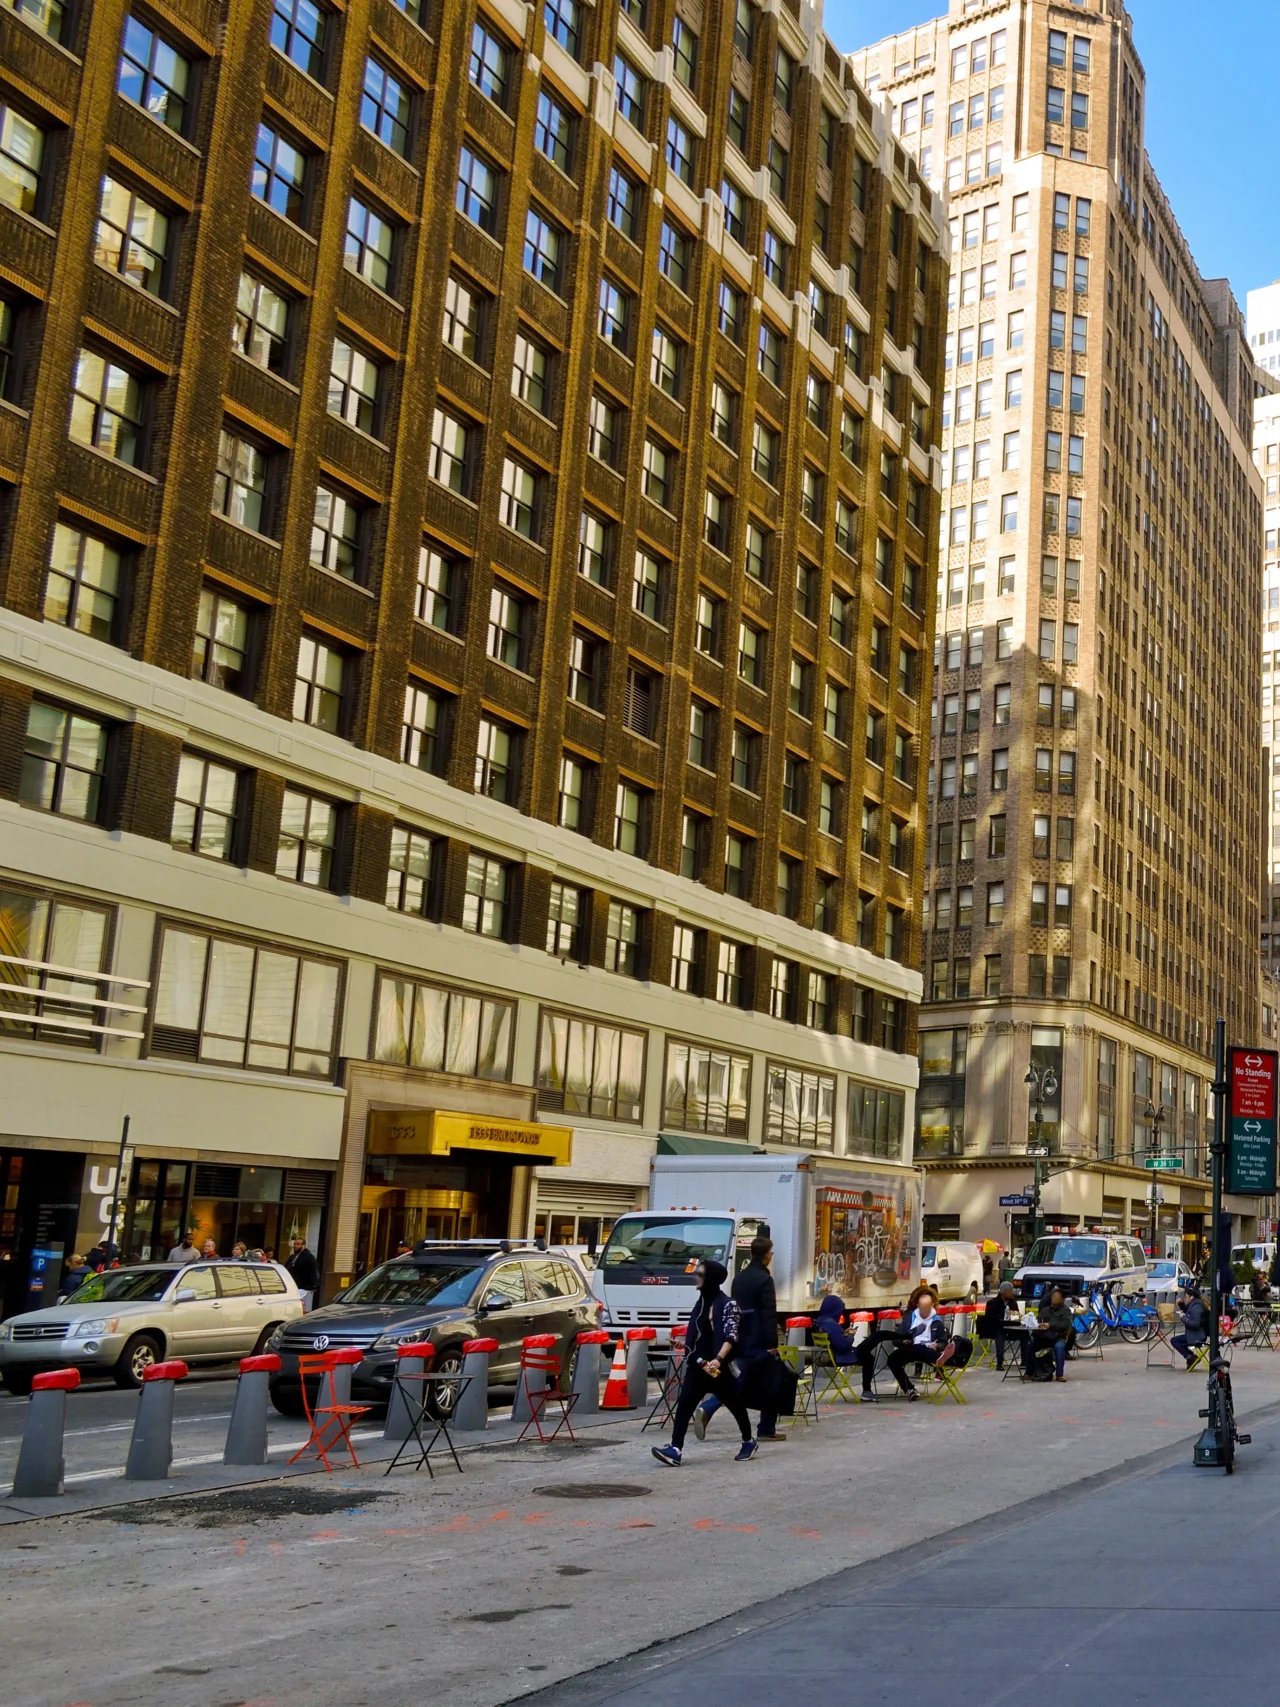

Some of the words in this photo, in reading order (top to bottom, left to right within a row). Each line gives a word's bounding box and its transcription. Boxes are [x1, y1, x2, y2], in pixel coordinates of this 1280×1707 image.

[1235, 1067, 1244, 1075] No
[1245, 1067, 1271, 1080] Standing
[1239, 1107, 1253, 1115] Monday
[1233, 1134, 1253, 1142] Metered
[1253, 1135, 1271, 1145] Parking
[1250, 1155, 1266, 1163] Midnight
[1249, 1169, 1266, 1177] Midnight
[1244, 1175, 1258, 1183] Saturday
[143, 1248, 149, 1257] A
[37, 1258, 45, 1270] P
[642, 1276, 669, 1284] GMC
